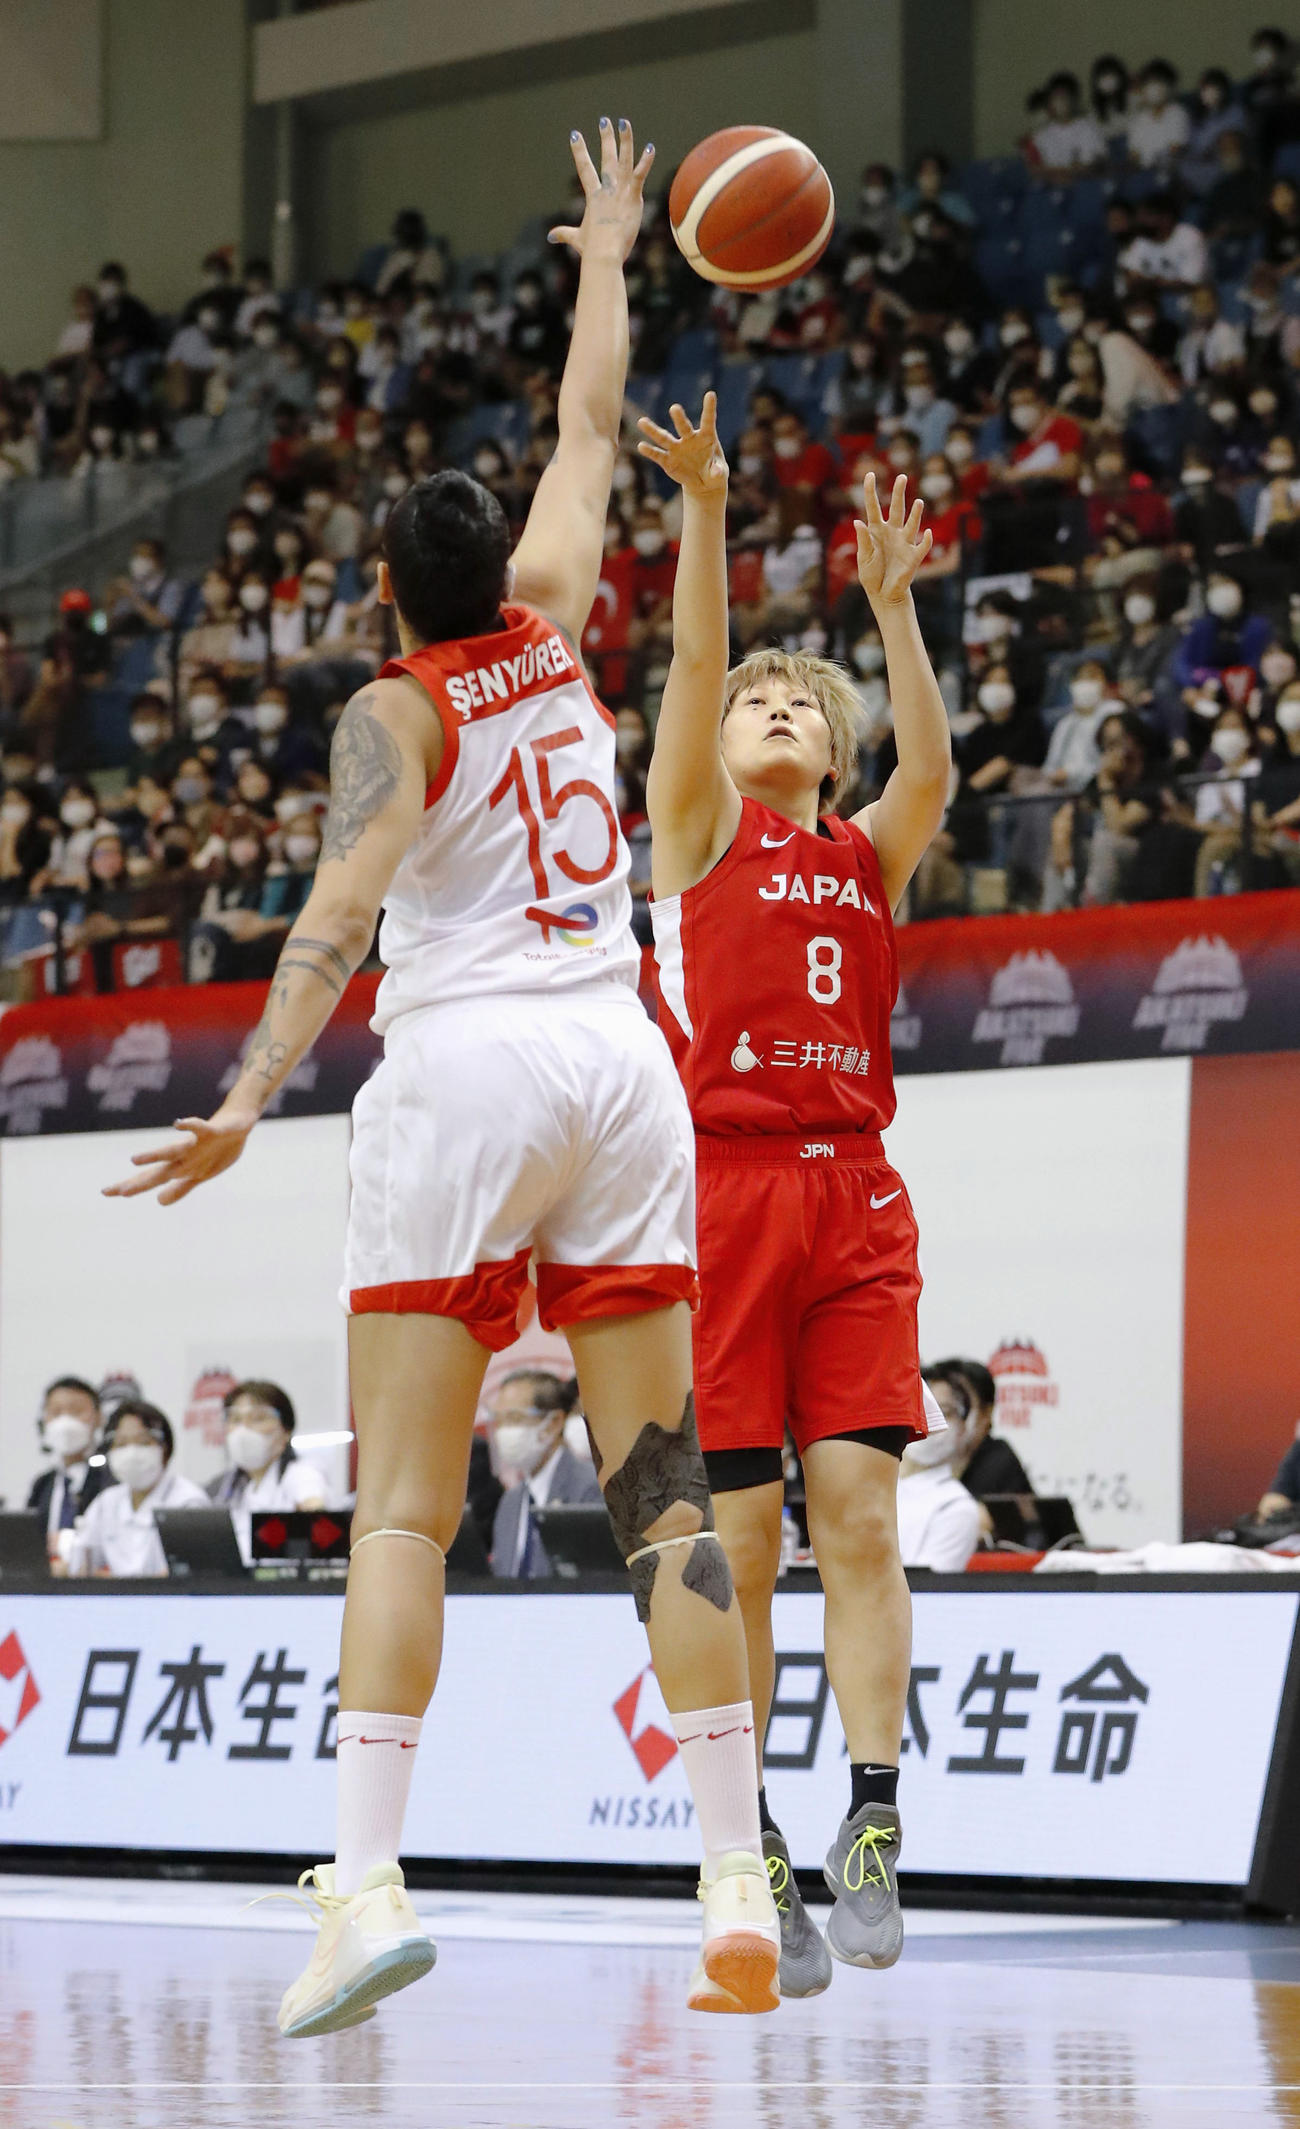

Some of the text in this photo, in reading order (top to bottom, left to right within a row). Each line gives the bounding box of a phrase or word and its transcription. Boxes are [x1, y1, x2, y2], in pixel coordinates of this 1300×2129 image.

[489, 726, 619, 900] 15
[806, 936, 843, 1005] 8
[770, 1040, 871, 1076] 三井不動産
[799, 1143, 835, 1159] JPN
[588, 1796, 695, 1828] NISSAY
